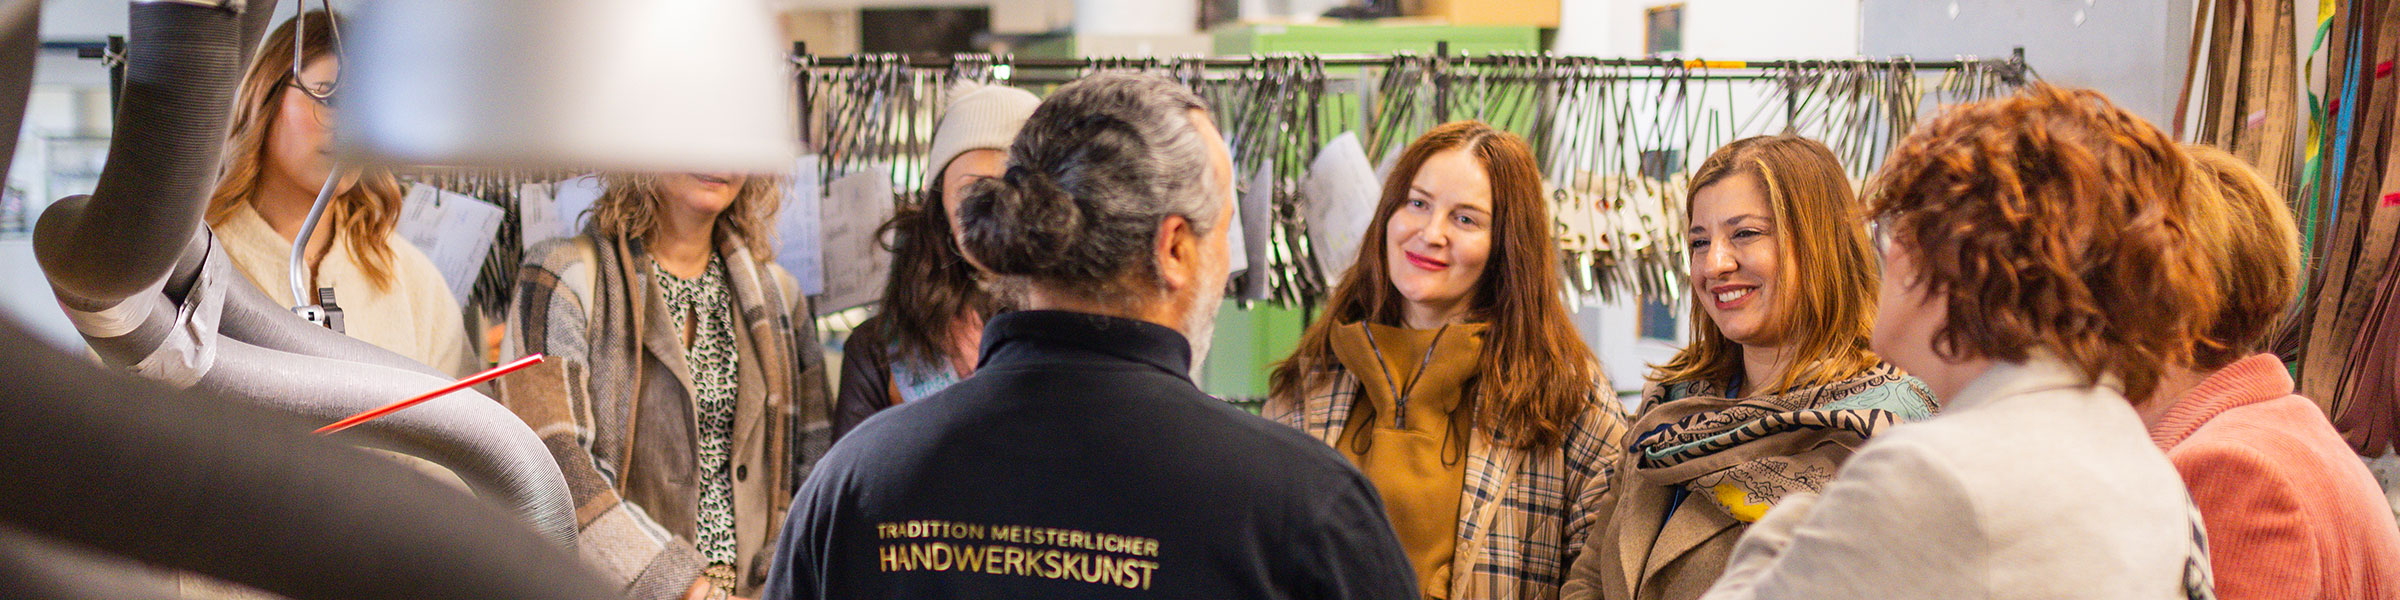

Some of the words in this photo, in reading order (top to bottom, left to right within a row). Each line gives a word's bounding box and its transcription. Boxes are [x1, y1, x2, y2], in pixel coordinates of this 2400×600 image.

[877, 520, 984, 539] TRADITION
[991, 525, 1159, 557] MEISTERLICHER
[879, 542, 1159, 590] HANDWERKSKUNST
